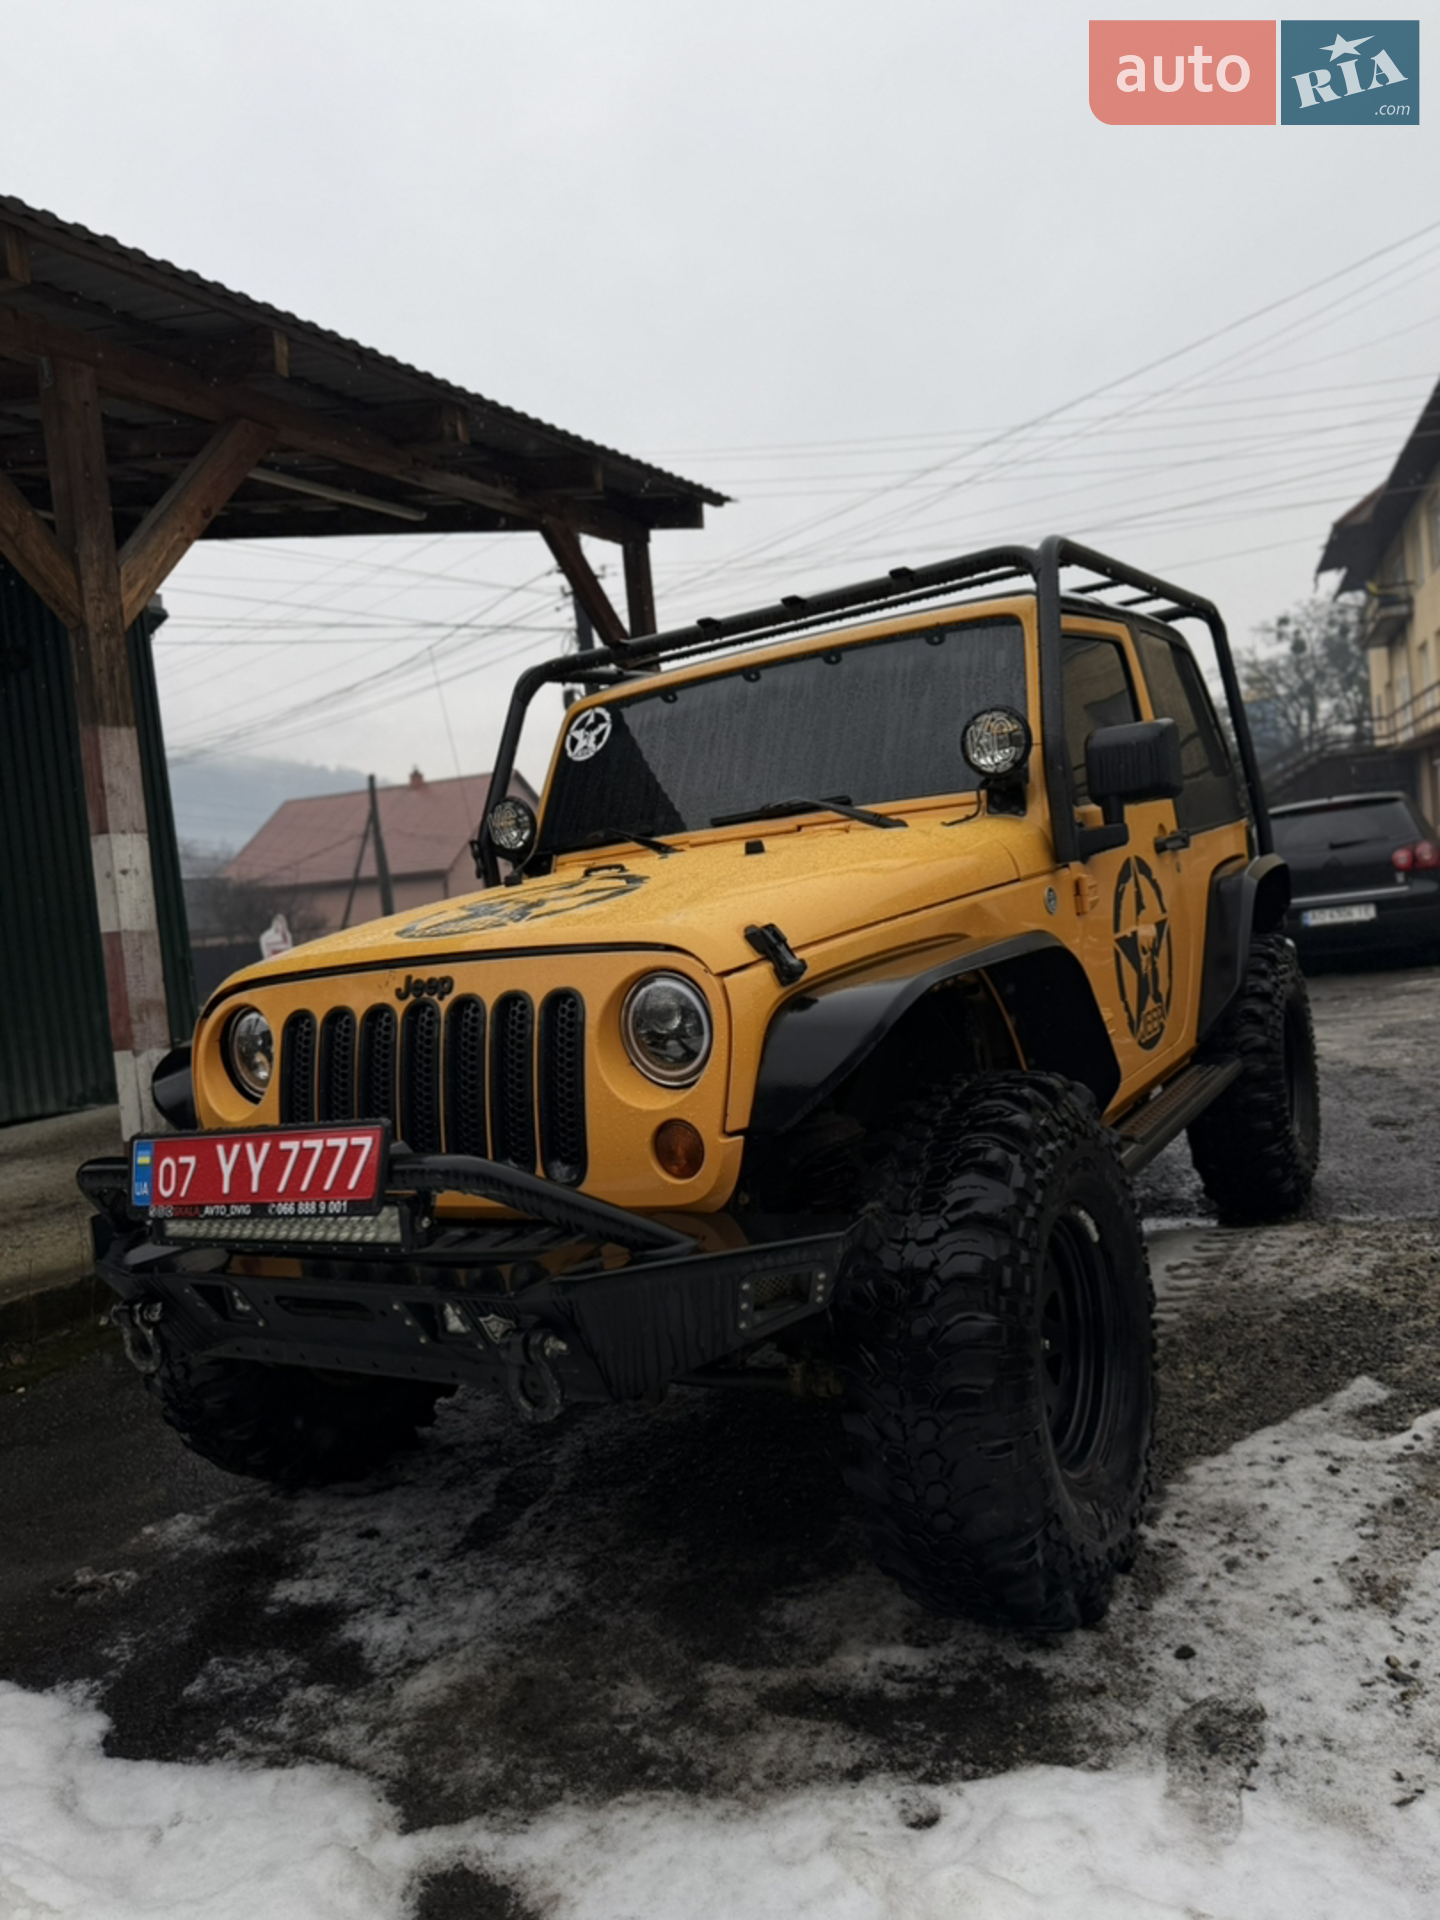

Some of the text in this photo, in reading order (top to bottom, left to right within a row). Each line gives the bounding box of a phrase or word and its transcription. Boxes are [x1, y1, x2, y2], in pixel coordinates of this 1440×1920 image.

[395, 974, 454, 1000] Jeep
[134, 1181, 150, 1197] UA
[157, 1156, 197, 1199] 07
